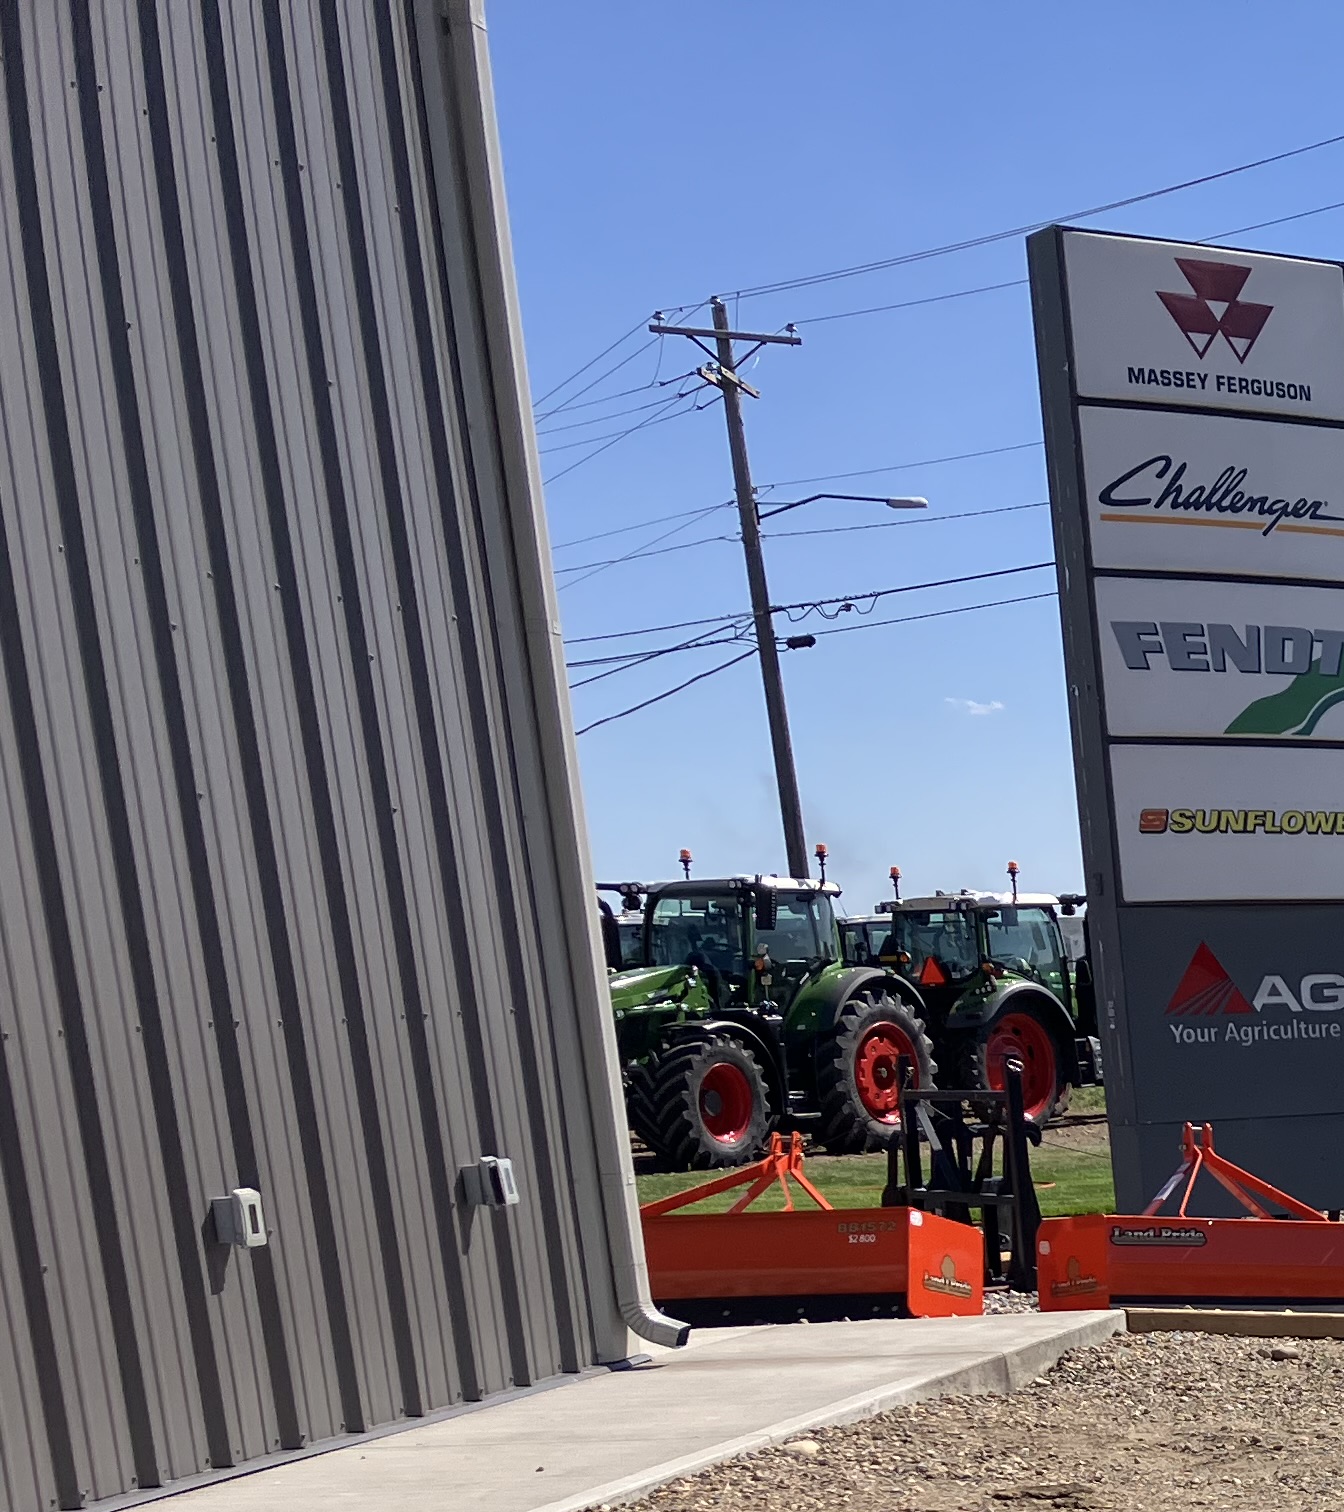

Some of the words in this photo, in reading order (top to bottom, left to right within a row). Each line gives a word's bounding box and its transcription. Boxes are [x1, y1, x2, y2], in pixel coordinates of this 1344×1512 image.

[1126, 366, 1209, 393] MASSEY
[1214, 375, 1313, 402] FERGUSON
[1168, 1023, 1219, 1045] Your
[1224, 1019, 1342, 1047] Agriculture
[1113, 1227, 1154, 1239] Land
[1161, 1228, 1204, 1240] Pride
